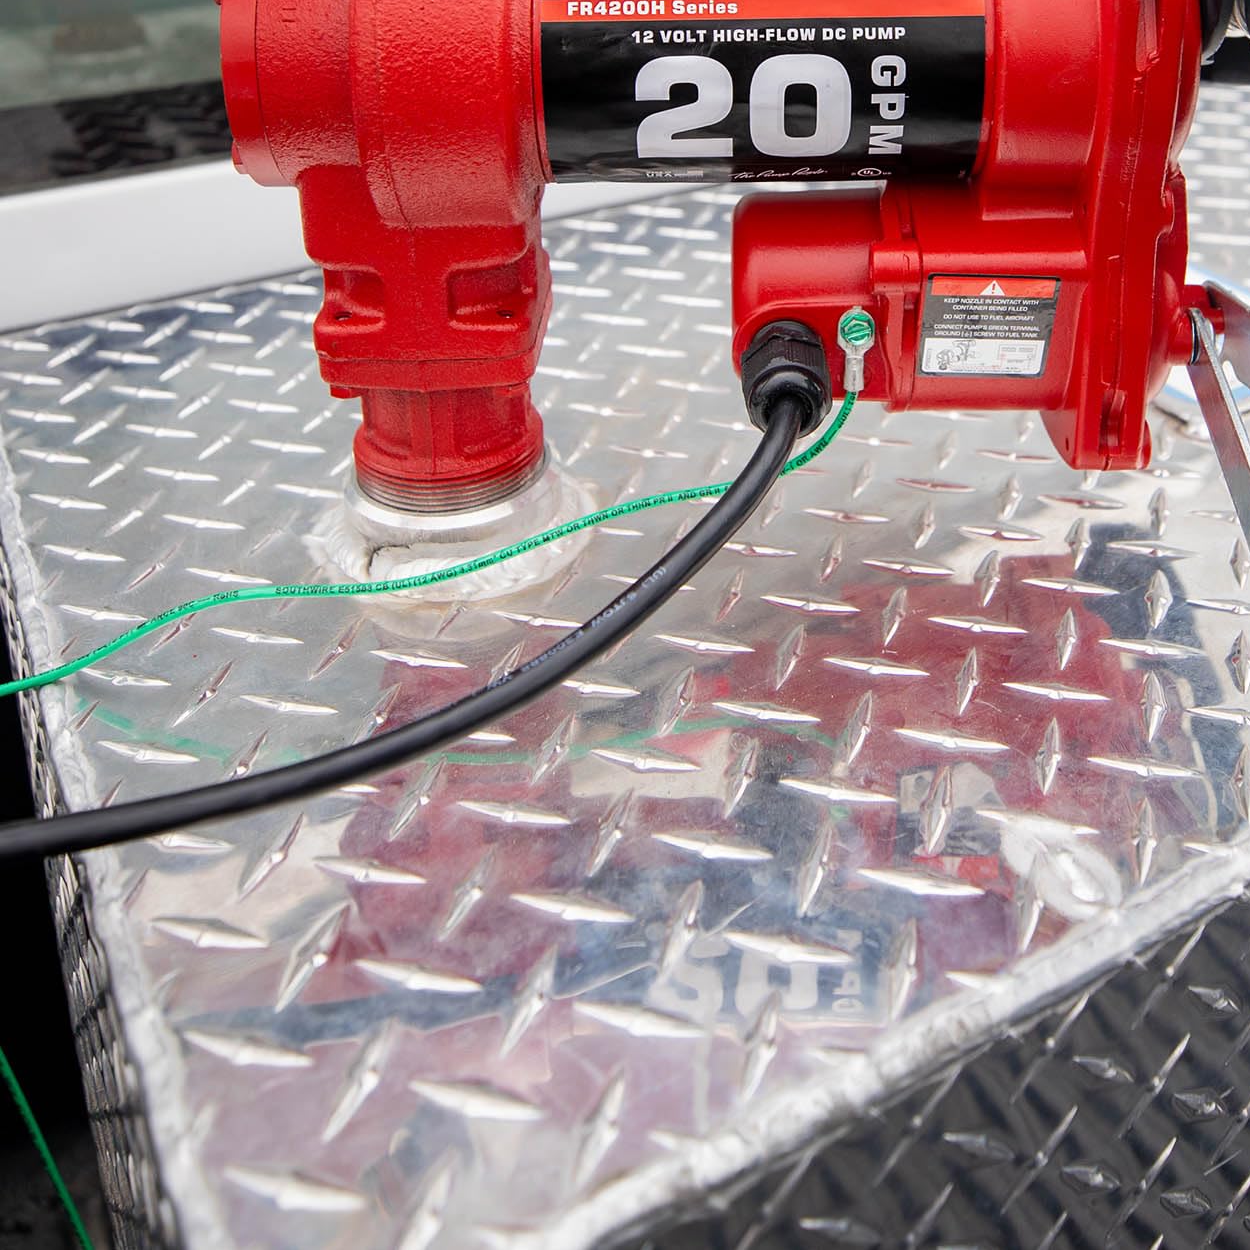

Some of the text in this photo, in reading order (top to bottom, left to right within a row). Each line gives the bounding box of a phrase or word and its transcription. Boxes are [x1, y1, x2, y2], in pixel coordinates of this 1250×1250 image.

[566, 0, 739, 17] FR4200H Series
[631, 26, 907, 44] 12 VOLT HIGH-FLOW DC PUMP
[634, 53, 853, 159] 20
[867, 54, 909, 156] GPM
[275, 584, 335, 595] SOUTHWIRE
[430, 568, 458, 582] AWG)
[517, 538, 540, 553] TYPE
[566, 522, 581, 533] OR
[611, 506, 625, 517] OR
[677, 491, 697, 501] AND
